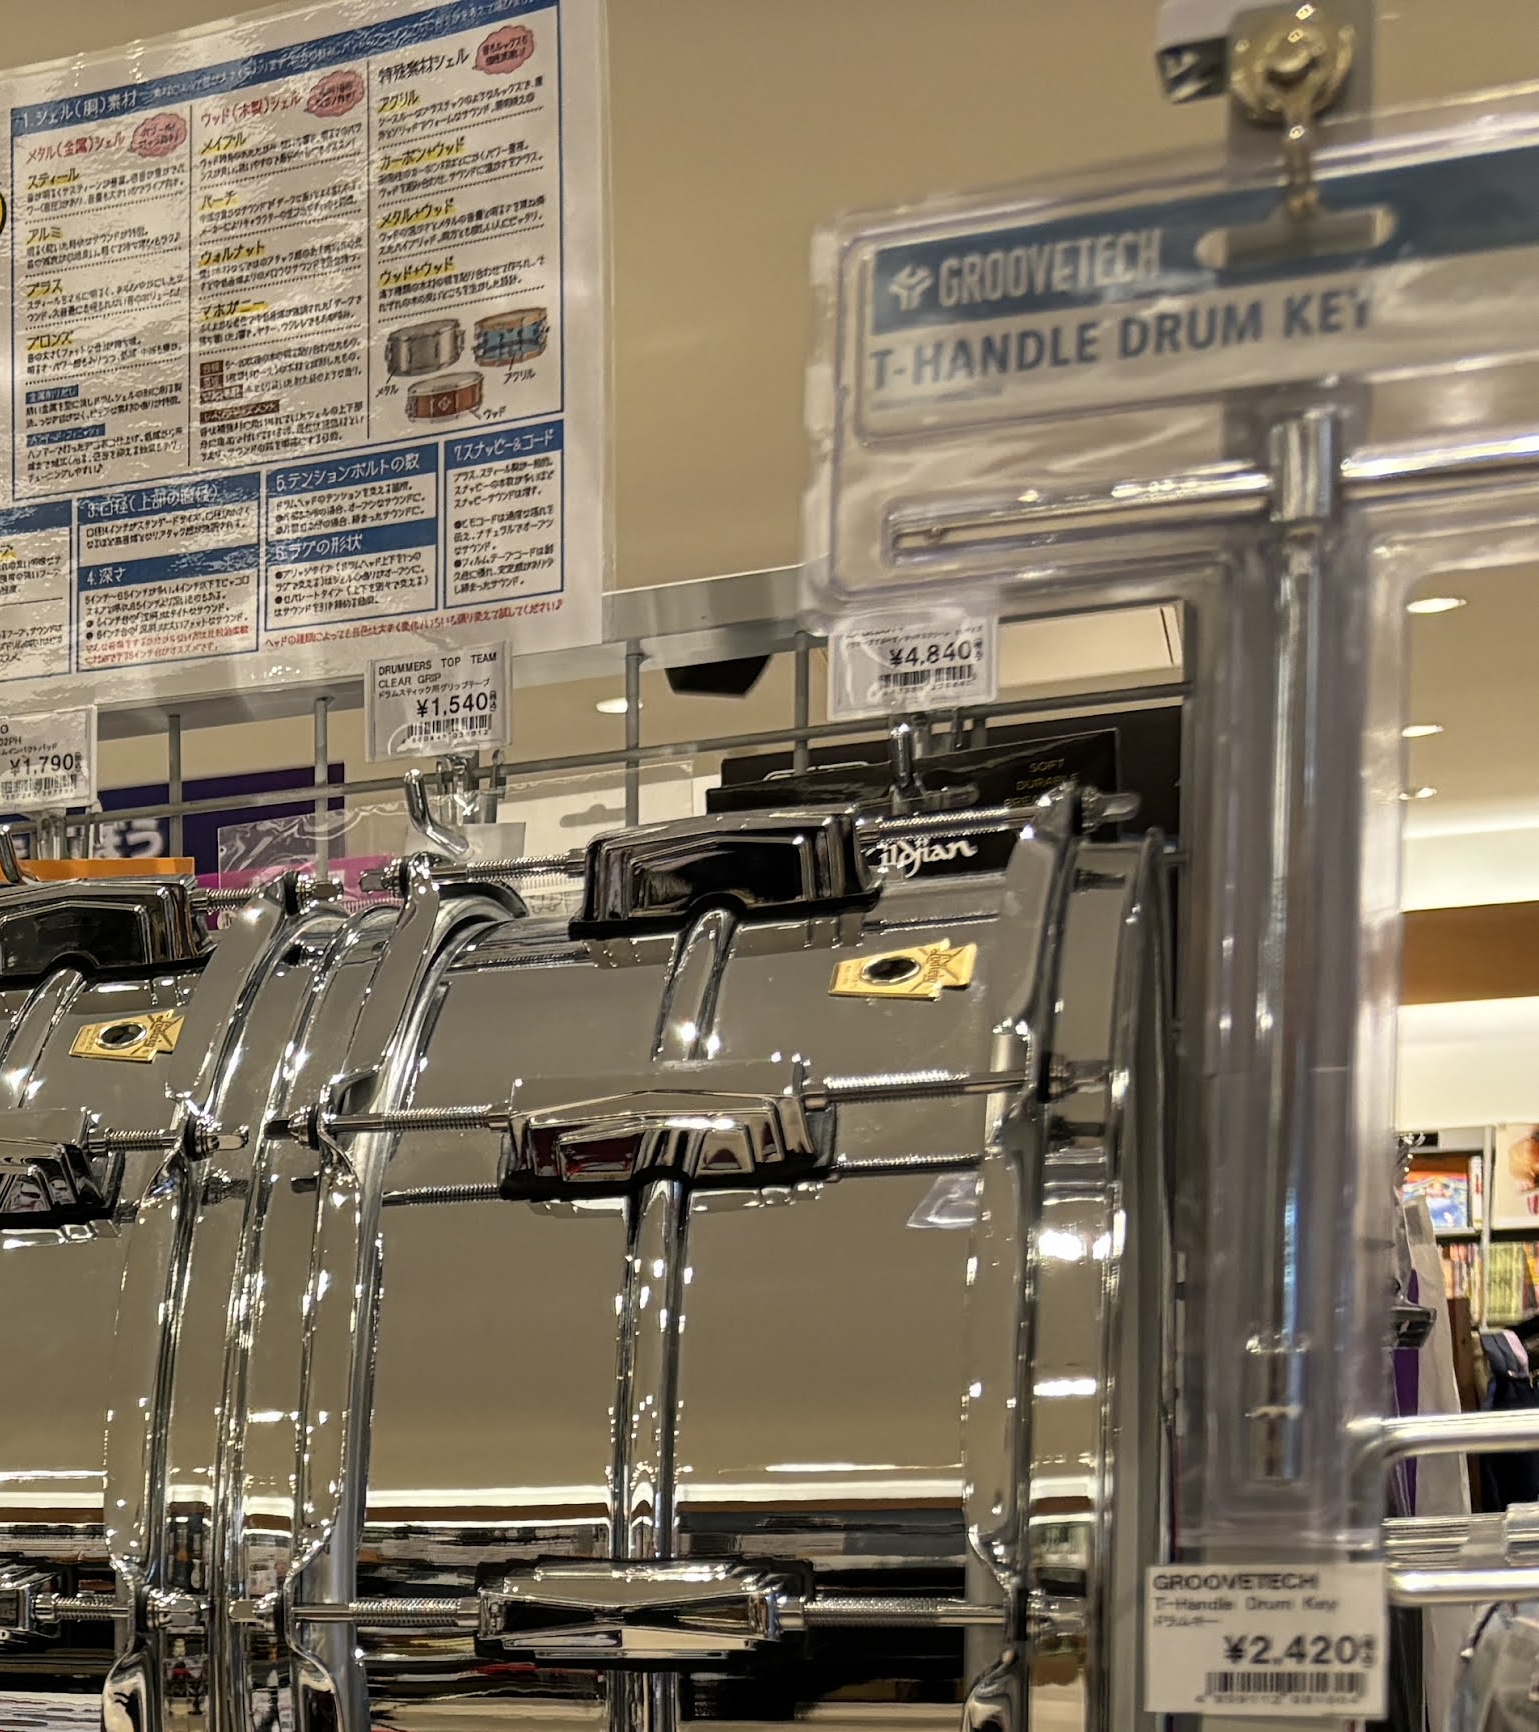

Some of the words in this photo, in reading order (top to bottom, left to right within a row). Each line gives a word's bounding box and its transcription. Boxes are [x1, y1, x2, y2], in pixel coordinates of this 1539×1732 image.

[941, 231, 1162, 309] GROOVETECH
[870, 321, 1101, 391] T-HANDLE
[1119, 298, 1262, 359] DRUM
[1284, 286, 1375, 338] KEY
[378, 659, 430, 676] DRUMMERS
[440, 657, 461, 668] TOP
[470, 652, 497, 665] TEAM
[378, 675, 412, 688] CLEAR
[418, 672, 442, 684] GRIP
[416, 692, 489, 717] ¥1,540
[10, 752, 74, 776] ¥1,790
[1153, 1574, 1316, 1591] GROOVETECH
